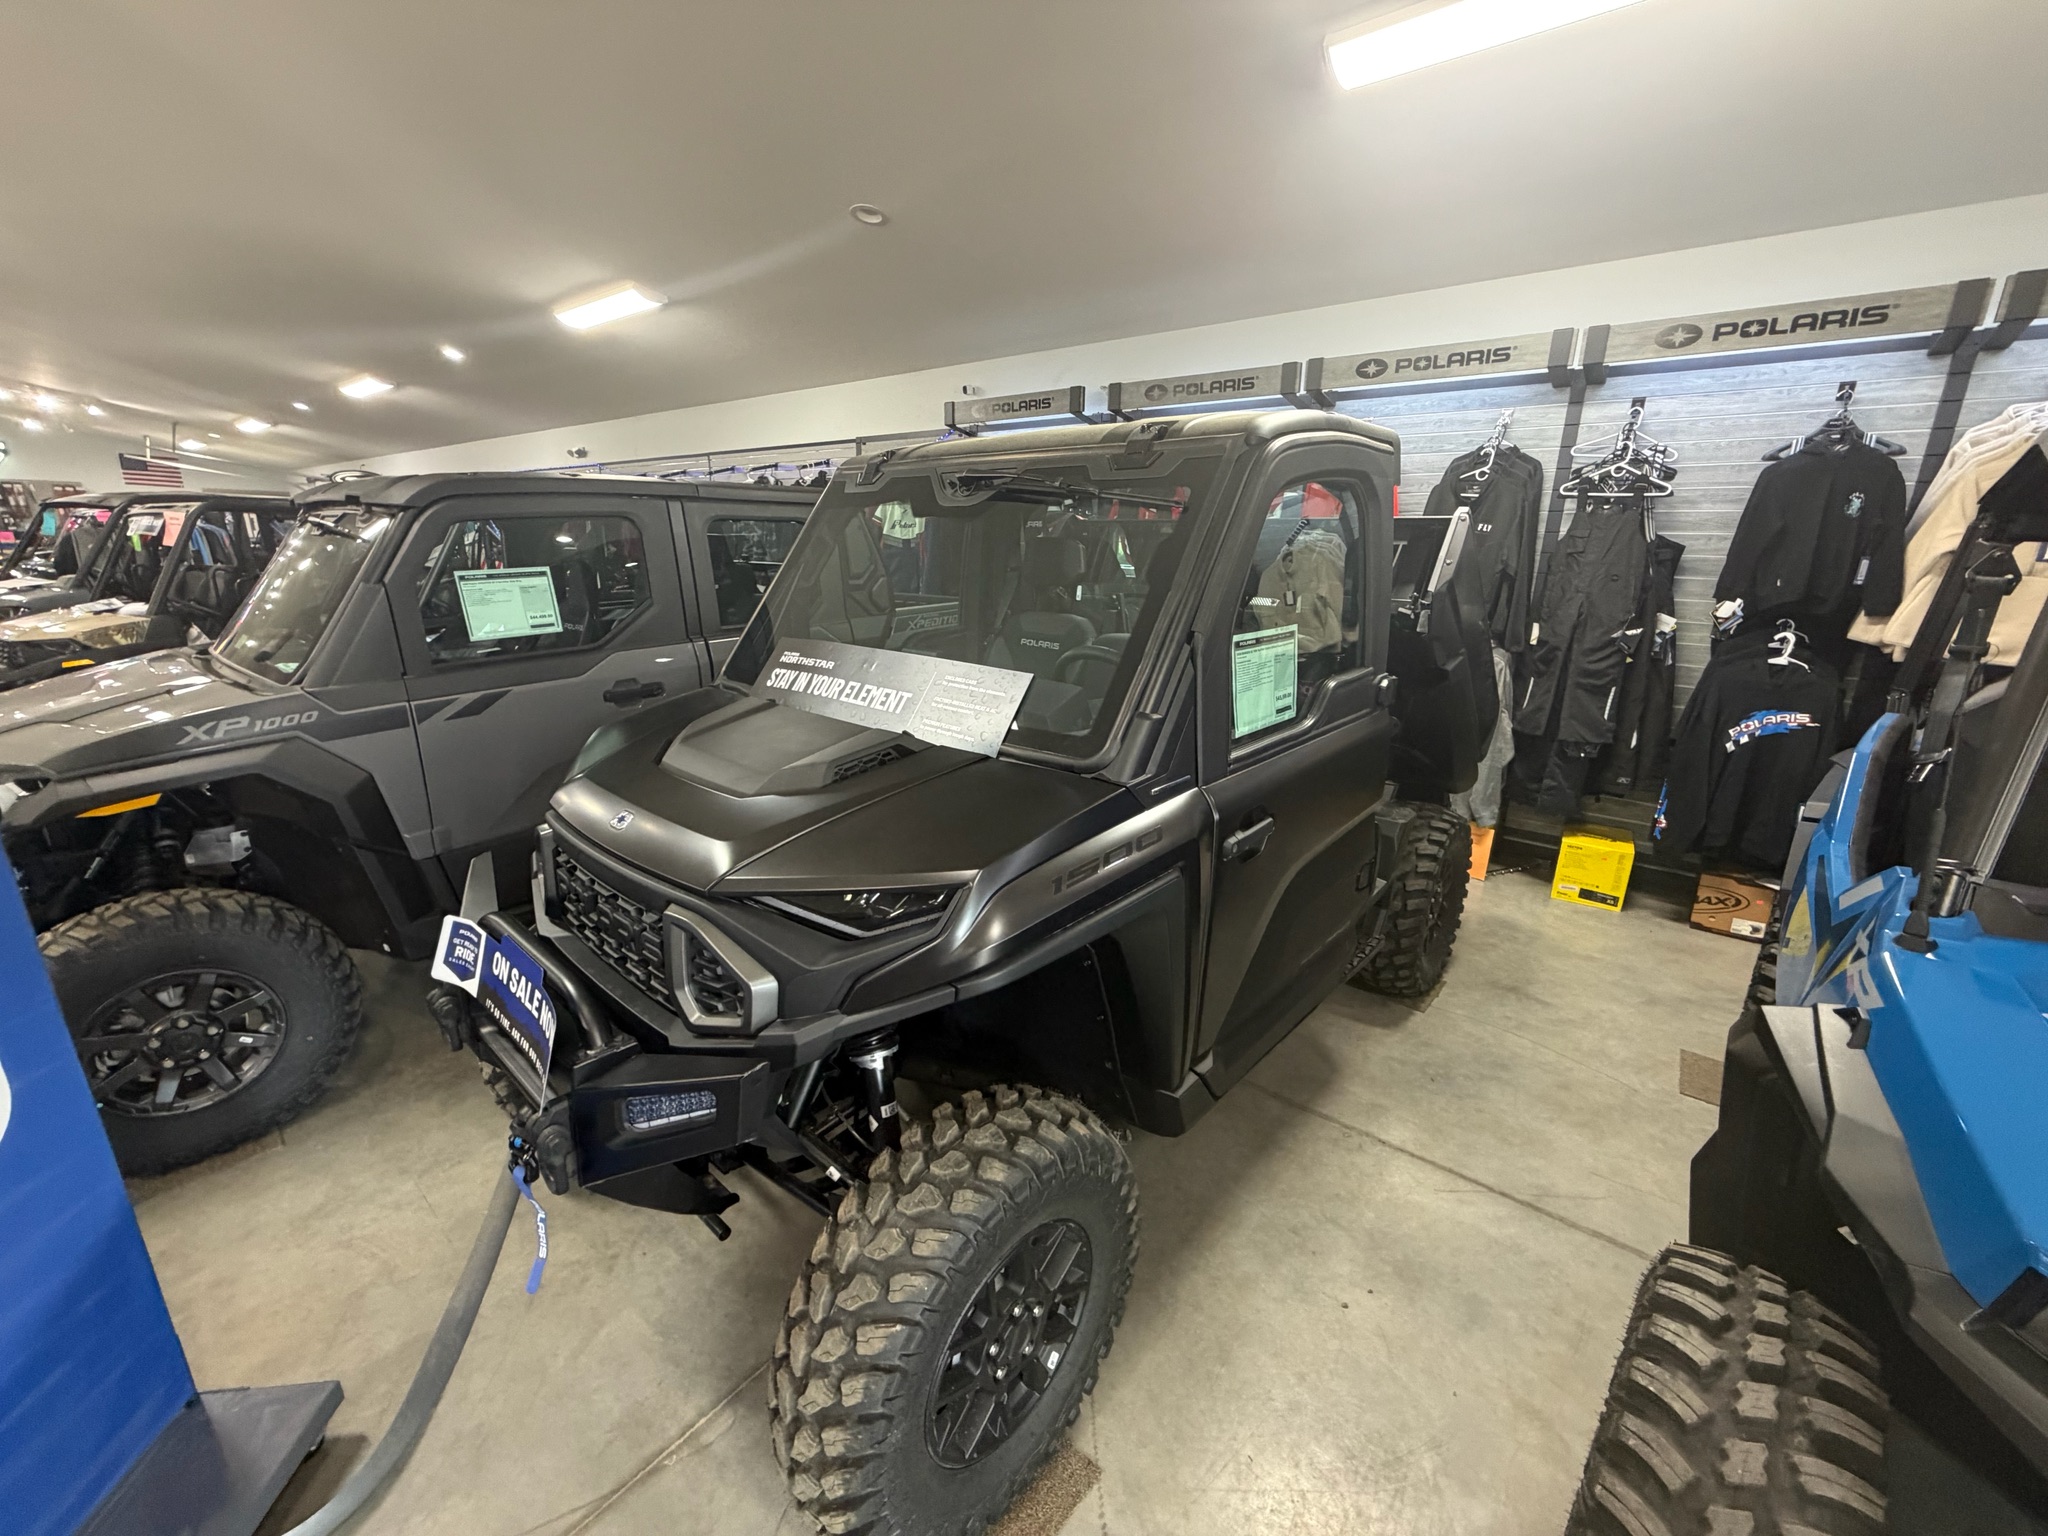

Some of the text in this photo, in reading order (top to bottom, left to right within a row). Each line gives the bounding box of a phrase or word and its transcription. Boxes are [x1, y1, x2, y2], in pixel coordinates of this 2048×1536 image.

[1712, 304, 1890, 341] POLARIS
[1395, 346, 1512, 374] POLARIS
[1173, 377, 1255, 397] POLARIS
[992, 398, 1052, 414] POLARIS
[1477, 523, 1492, 532] FLY
[907, 614, 958, 631] XPEDITIO
[1020, 638, 1060, 650] POLARIS
[780, 654, 835, 669] NORTHSTAR
[766, 668, 913, 714] STAY IN YOUR ELEMENT
[176, 711, 319, 745] XP 1000
[1728, 713, 1812, 740] POLARIS
[1051, 824, 1163, 896] 1500
[448, 957, 465, 965] SALES
[454, 946, 475, 965] RIDE
[492, 951, 510, 985] ON
[509, 967, 541, 1019] SALE
[511, 1027, 520, 1043] ASK
[519, 1035, 529, 1053] FOR
